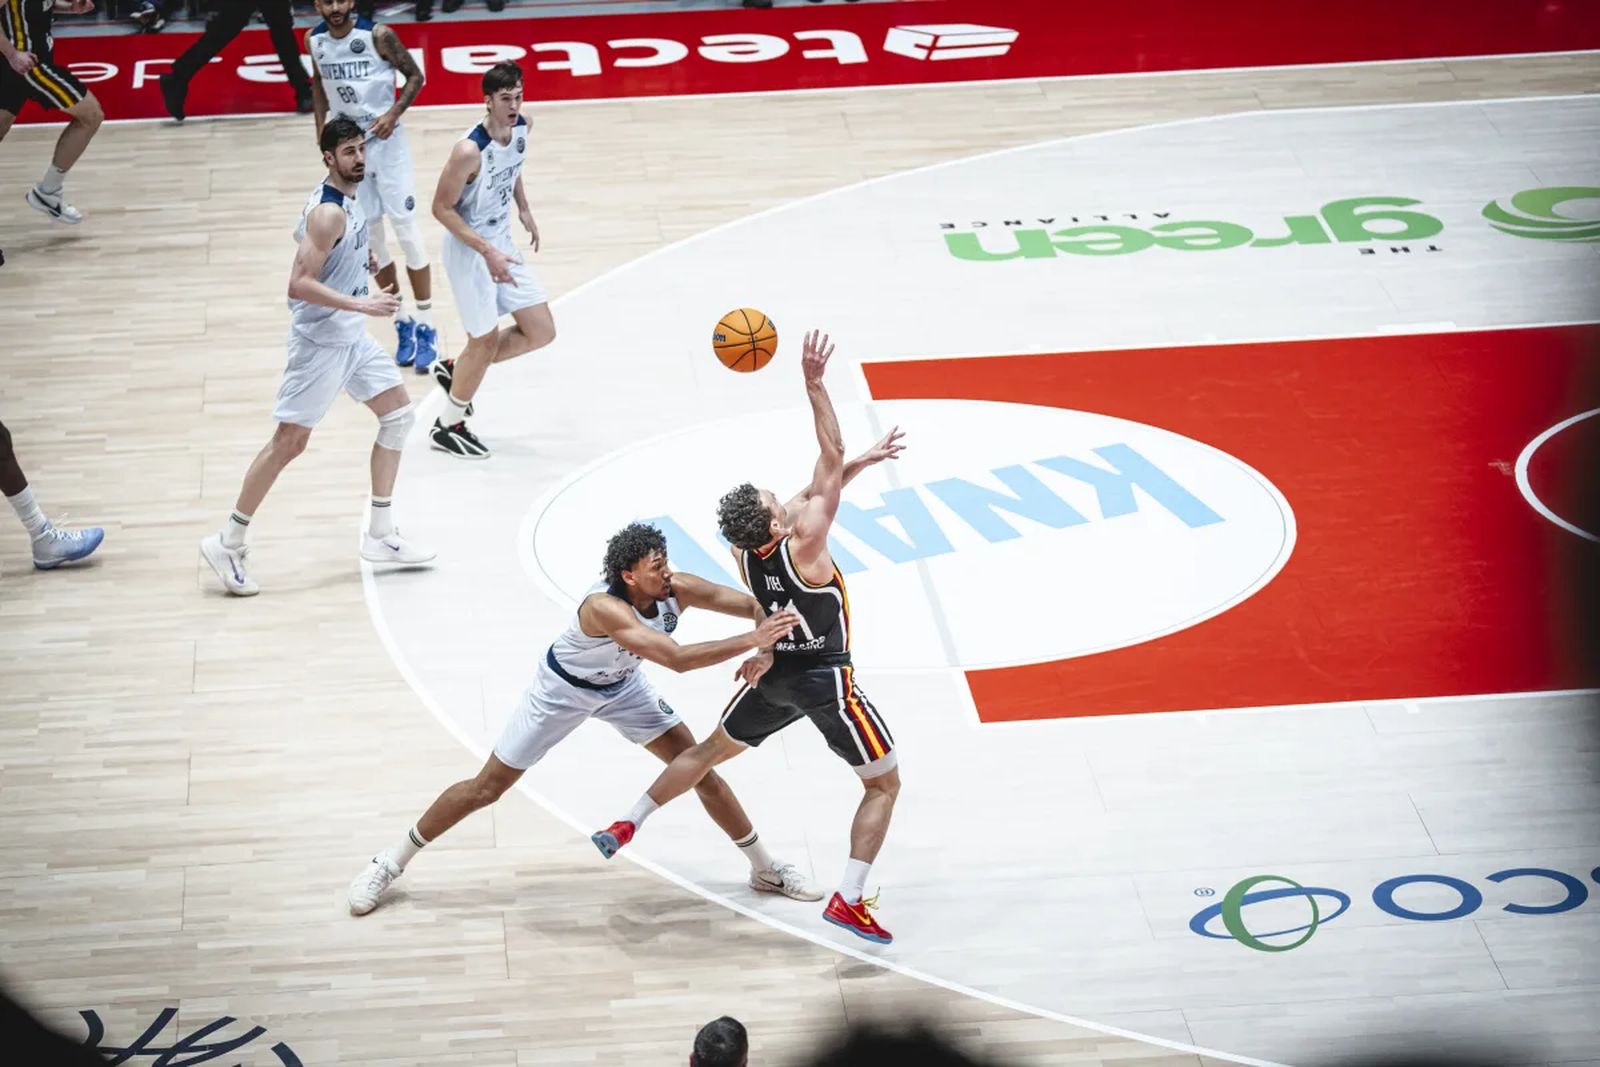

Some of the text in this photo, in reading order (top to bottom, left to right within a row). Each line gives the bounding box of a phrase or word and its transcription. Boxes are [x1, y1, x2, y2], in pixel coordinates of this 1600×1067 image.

[67, 29, 870, 89] tectae.de
[336, 86, 358, 104] 88
[940, 212, 1171, 230] ALLIANCE
[943, 195, 1444, 262] green
[1358, 244, 1443, 256] THE
